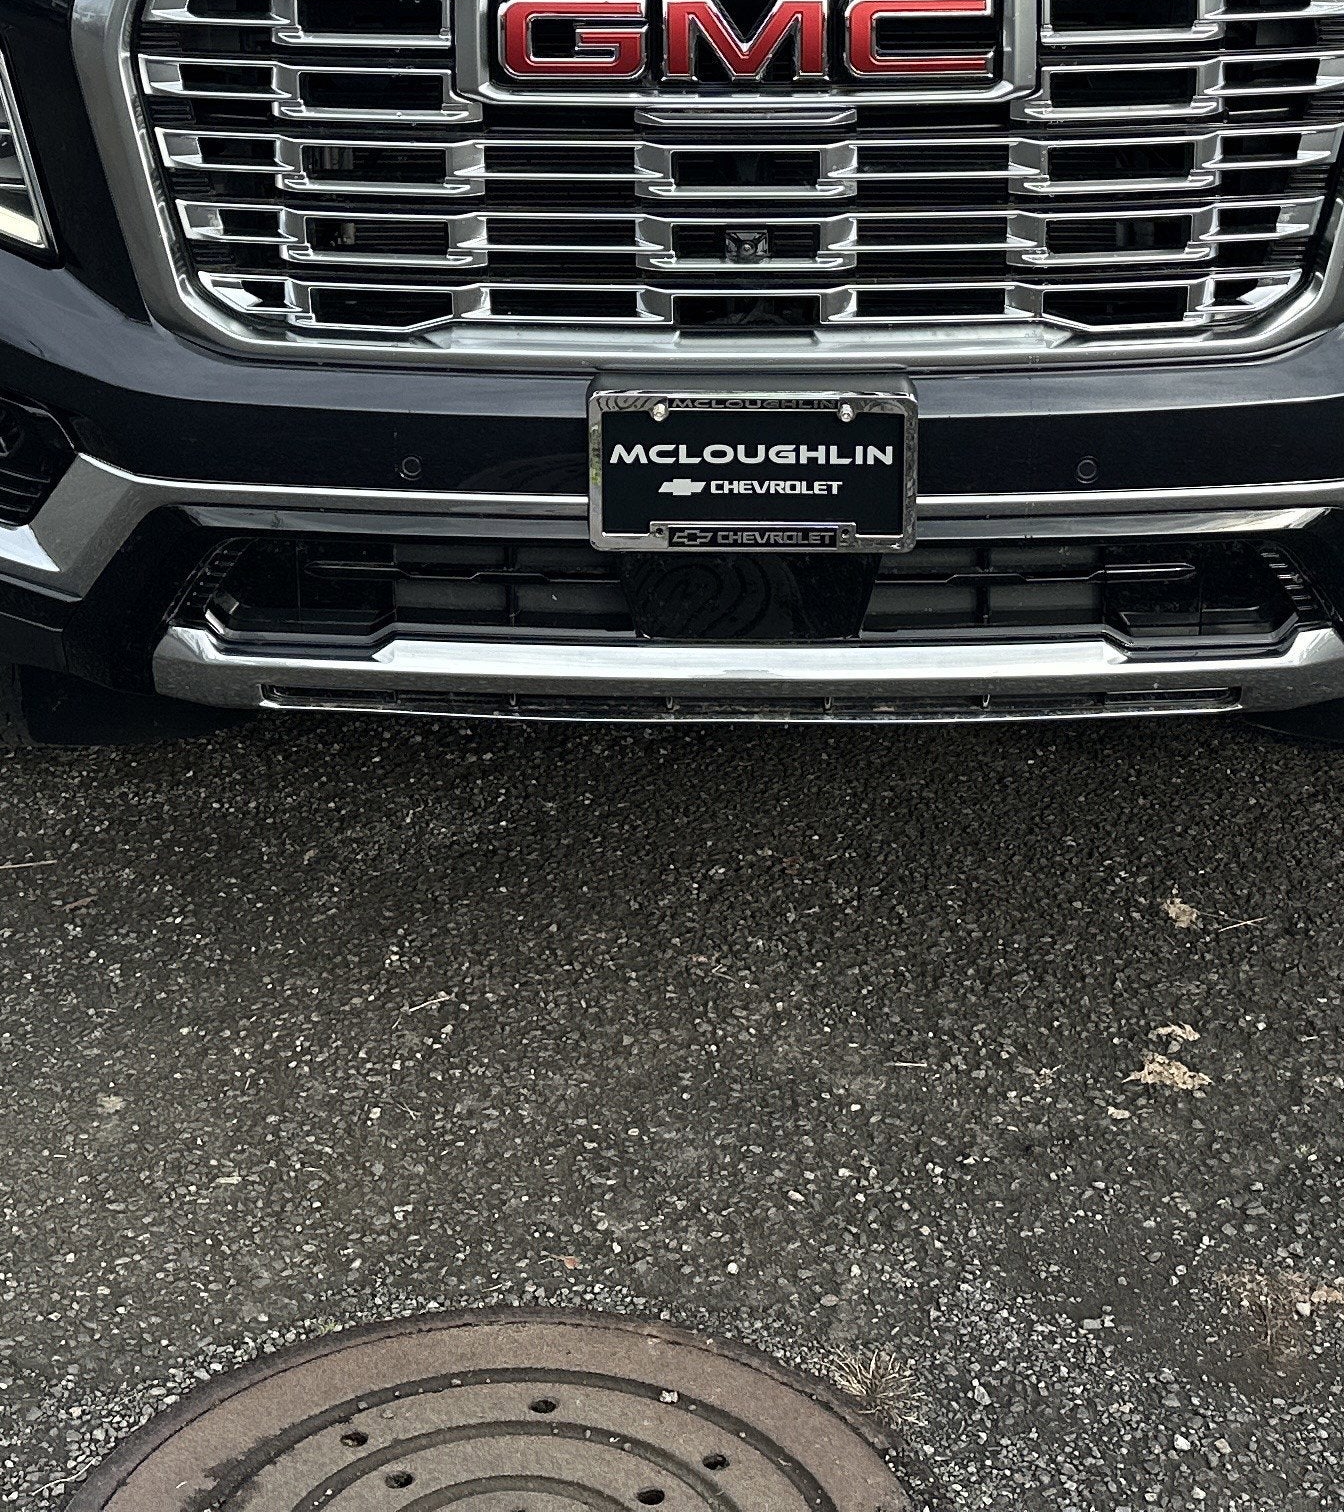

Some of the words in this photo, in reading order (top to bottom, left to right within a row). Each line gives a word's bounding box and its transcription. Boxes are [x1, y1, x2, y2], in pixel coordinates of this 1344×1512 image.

[670, 398, 839, 410] MCLOUGHLIN
[609, 443, 894, 465] MCLOUGHLIN
[710, 480, 843, 495] CHEVROLET
[716, 531, 834, 545] CHEVROLET
